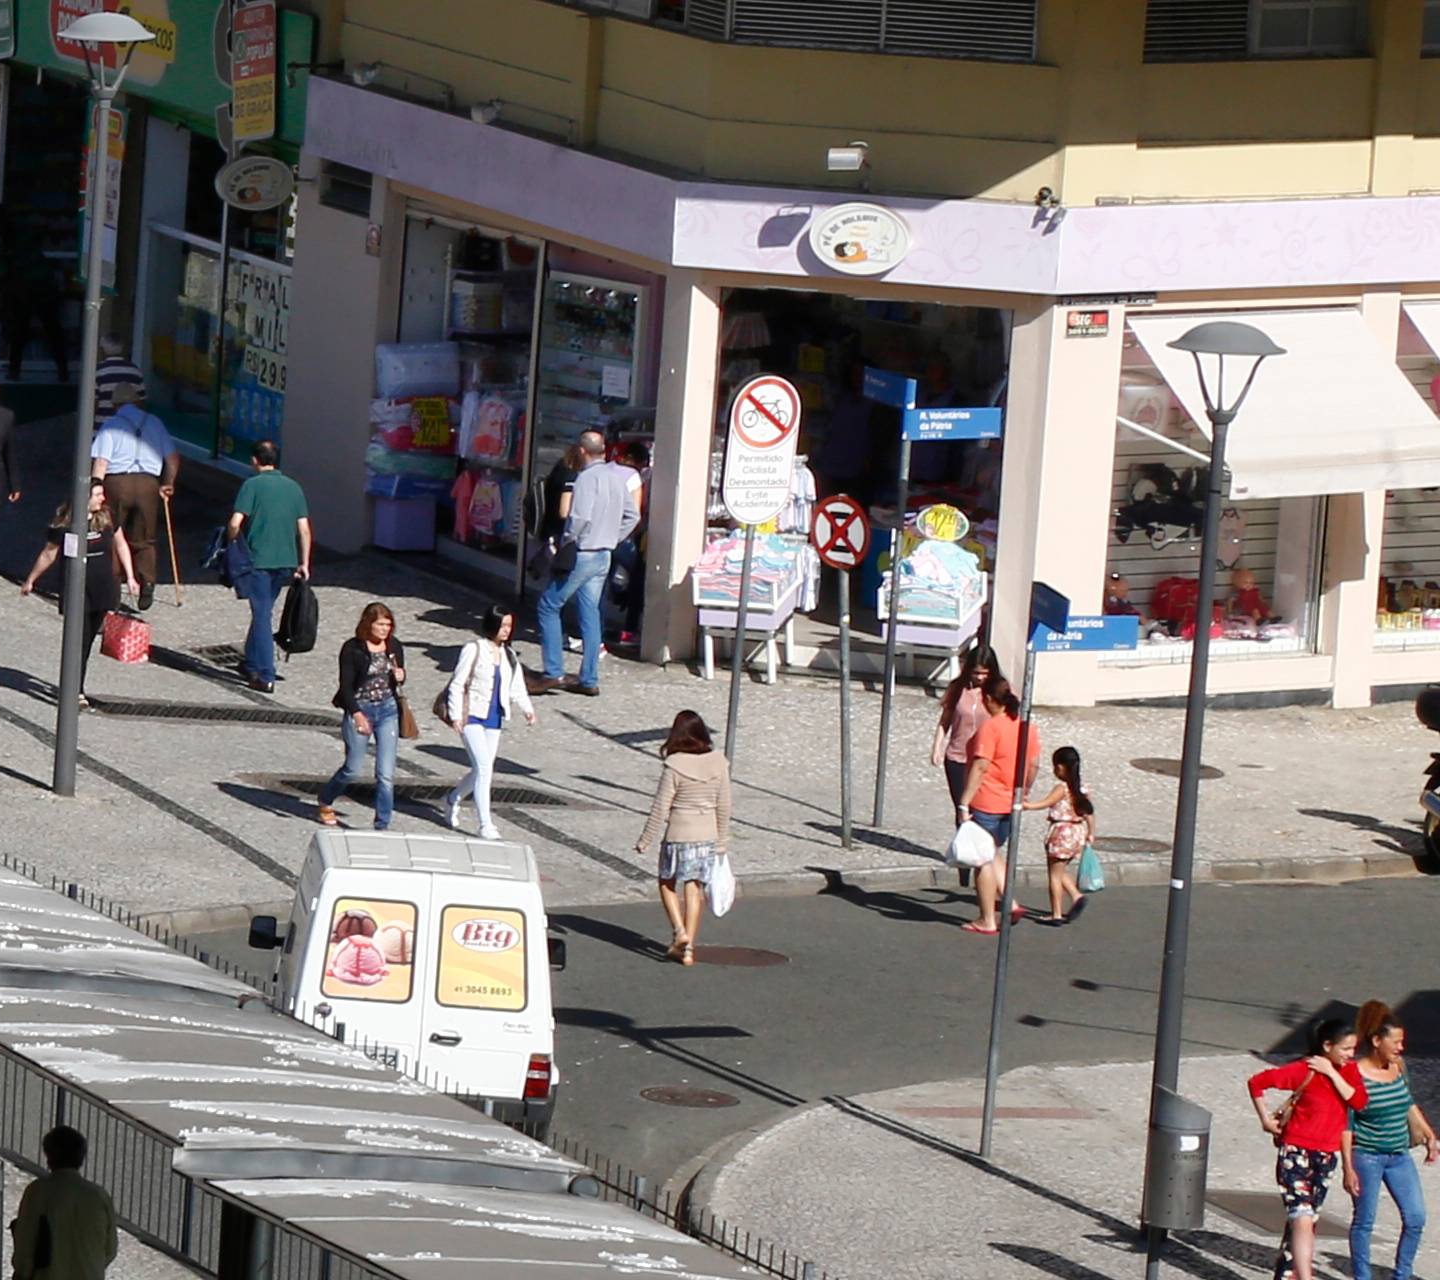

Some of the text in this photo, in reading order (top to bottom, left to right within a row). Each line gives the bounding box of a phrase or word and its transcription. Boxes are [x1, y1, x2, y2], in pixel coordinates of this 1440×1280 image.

[842, 214, 878, 226] MOLEQUE
[929, 411, 971, 420] Voluntários
[919, 420, 953, 430] da Pátria
[739, 453, 784, 465] Permitido
[742, 465, 777, 475] Ciclista
[728, 477, 788, 488] Desmontado
[745, 489, 768, 502] Evite
[733, 499, 779, 510] Acidentes
[463, 923, 513, 949] Big
[466, 985, 489, 995] 3045
